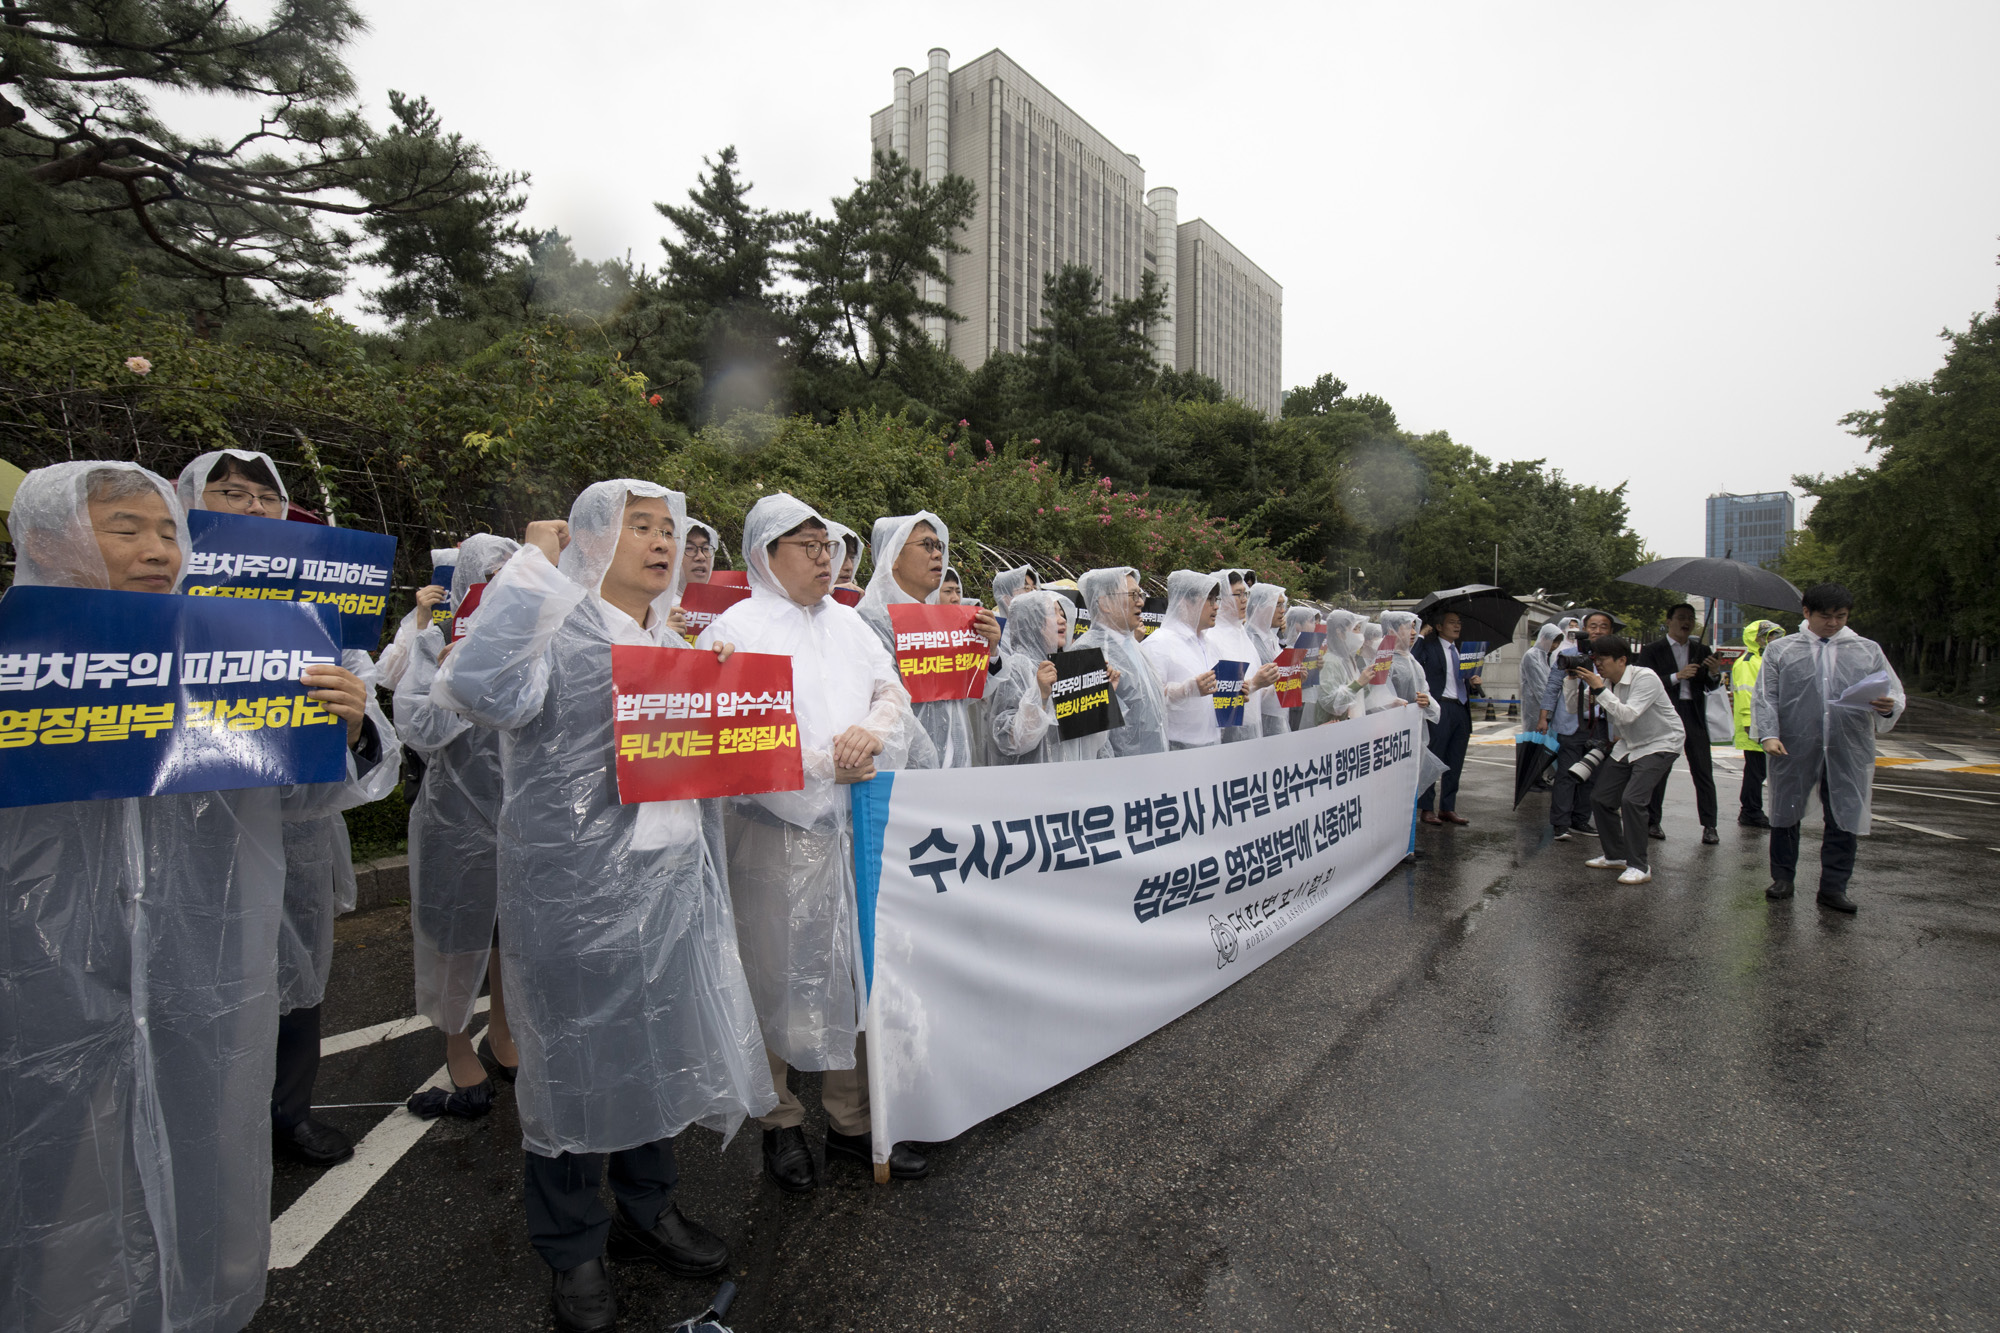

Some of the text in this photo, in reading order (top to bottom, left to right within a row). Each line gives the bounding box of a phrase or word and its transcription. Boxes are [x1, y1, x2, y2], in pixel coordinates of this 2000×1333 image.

[187, 552, 388, 587] 법치주의 파괴하는
[896, 631, 950, 652] 법무법인
[0, 652, 173, 692] 법치주의
[900, 655, 953, 677] 무너지는
[1051, 669, 1110, 699] 민주주의 파괴하는
[617, 690, 792, 722] 법무법인 압수수색
[1056, 689, 1110, 720] 변호사 압수수색
[0, 702, 175, 749] 영장발부
[620, 724, 797, 762] 무너지는 헌정질서
[908, 728, 1413, 894] 수사기관은 변호사 사무실 압수수색 행위를 중단하고,
[1133, 794, 1362, 924] 법원은 영장발부에 신중하라
[1227, 866, 1336, 933] 대한변호사협회
[1245, 886, 1329, 951] KOREAN BAR ASSOCIATION
